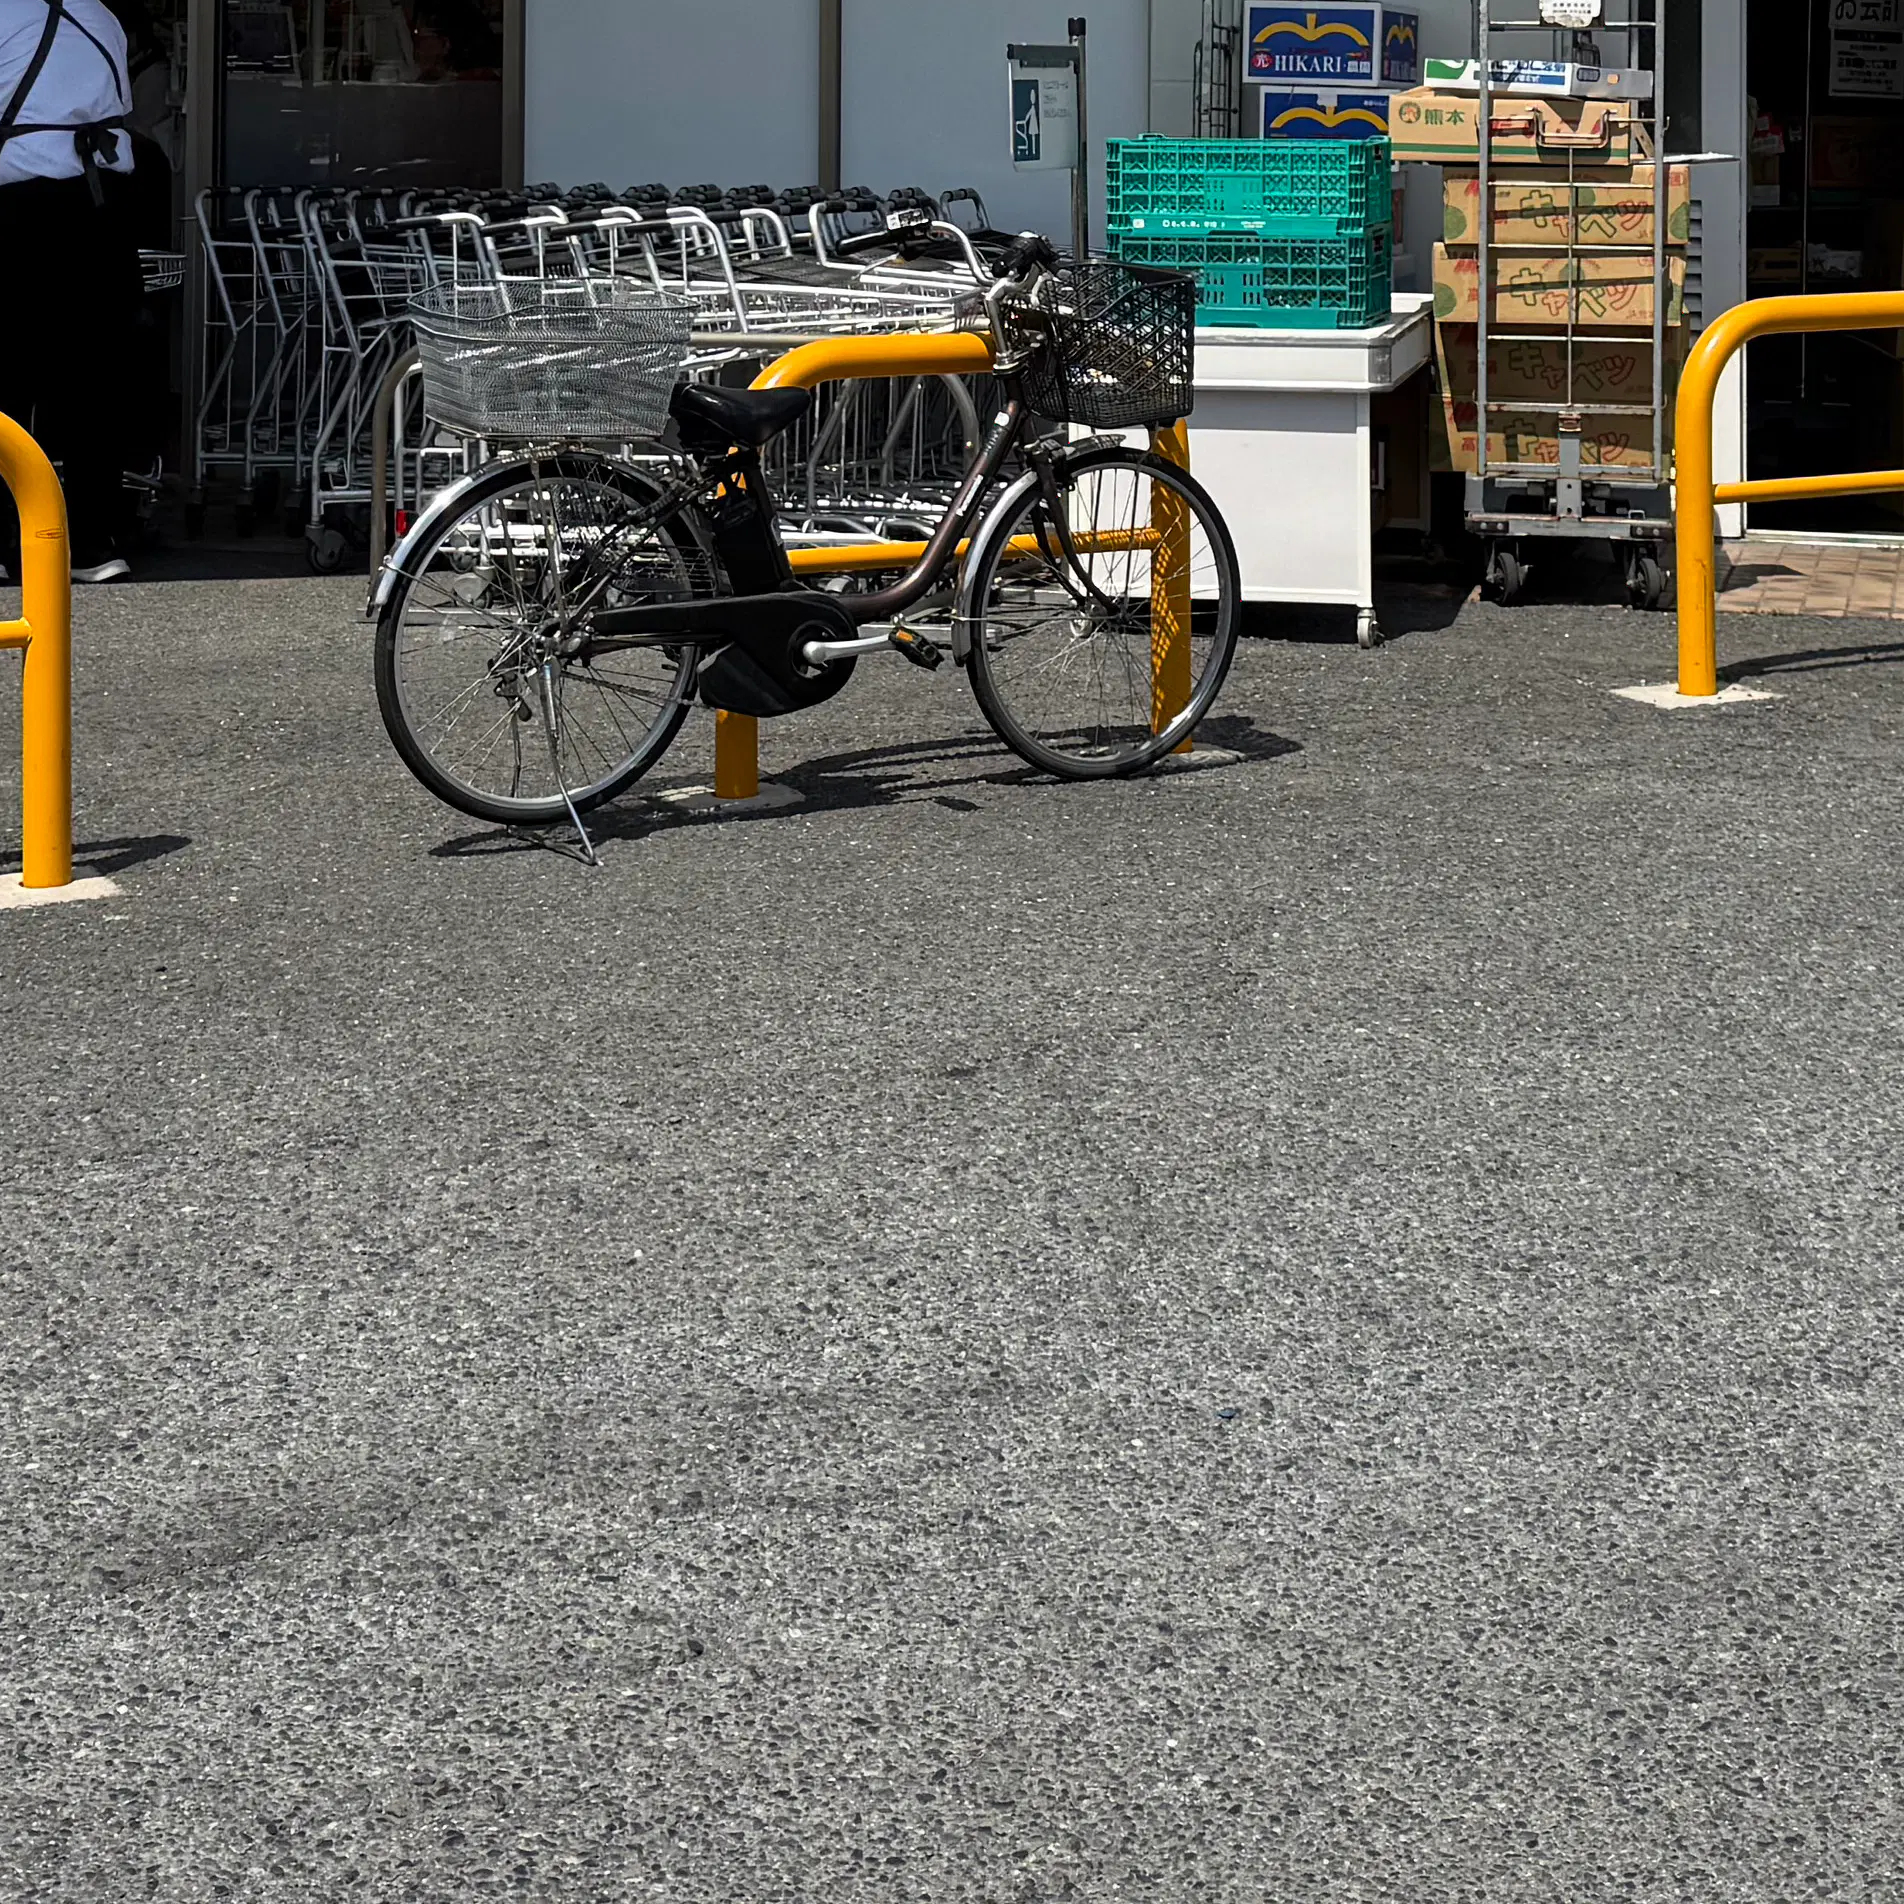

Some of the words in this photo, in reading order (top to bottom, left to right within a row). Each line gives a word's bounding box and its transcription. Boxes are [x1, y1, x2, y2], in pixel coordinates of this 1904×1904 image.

[1274, 55, 1342, 73] HIKARI
[1424, 108, 1466, 126] 熊本
[1520, 190, 1648, 238] キャベツ
[1509, 267, 1638, 318] キャベツ
[1508, 342, 1637, 392] キャベツ
